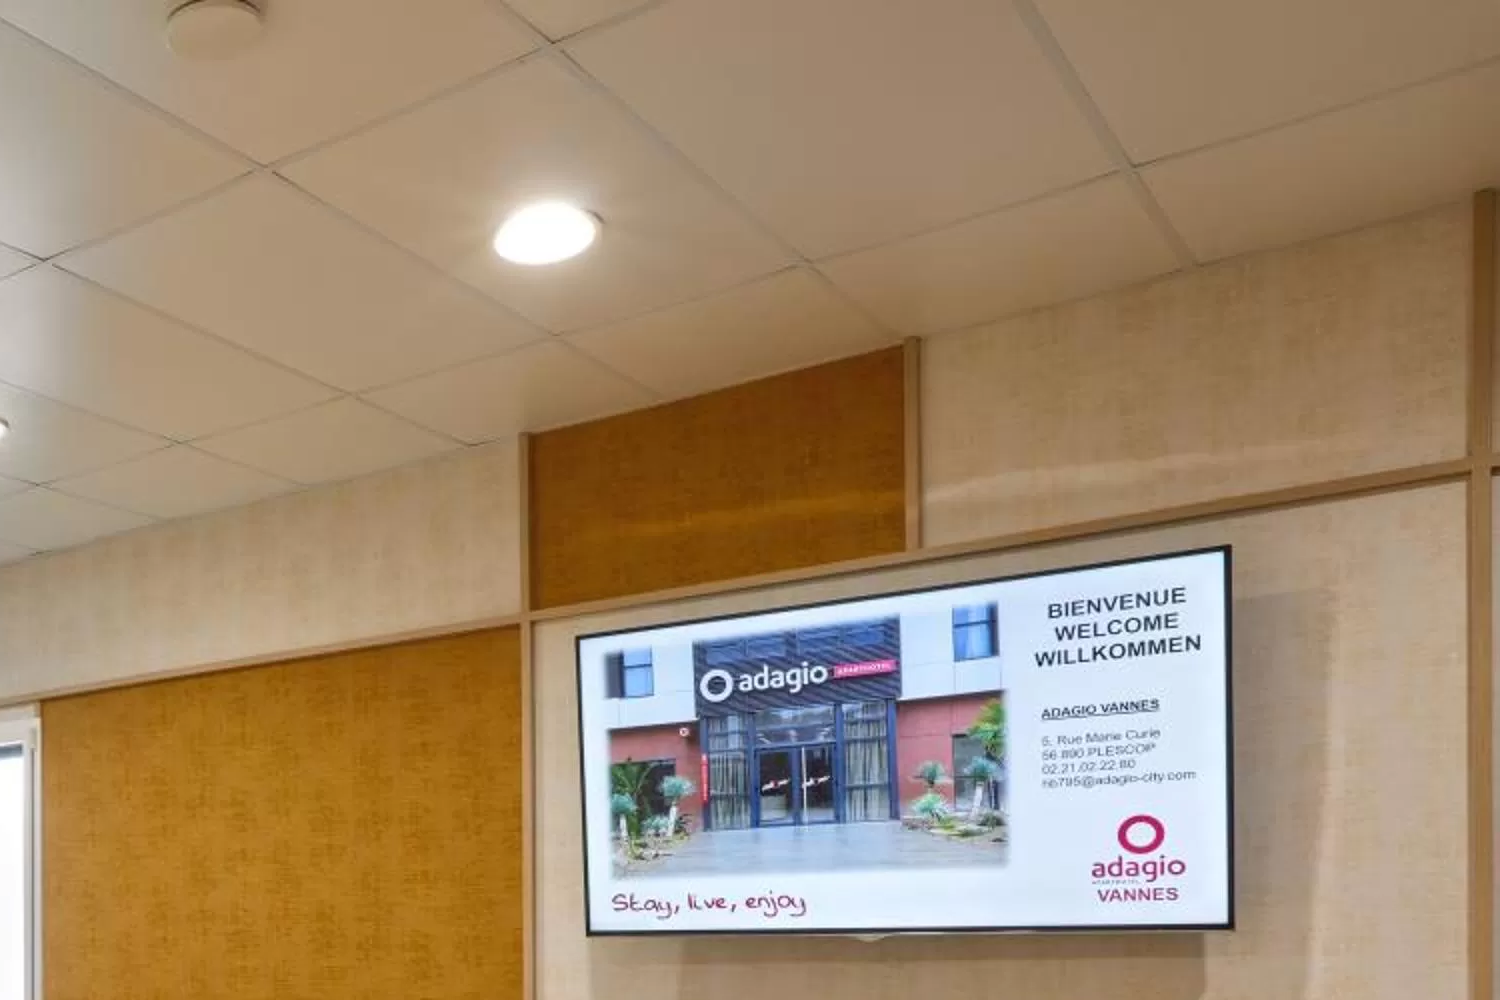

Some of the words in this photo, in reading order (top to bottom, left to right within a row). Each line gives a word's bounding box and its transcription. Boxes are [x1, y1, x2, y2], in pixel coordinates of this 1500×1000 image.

[1048, 586, 1187, 619] BIENVENUE
[1055, 612, 1179, 641] WELCOME
[1034, 634, 1202, 667] WILLKOMMEN
[738, 661, 829, 693] adagio
[1041, 703, 1097, 720] ADAGIO
[1099, 697, 1161, 714] VANNES
[1057, 734, 1084, 746] Rue
[1125, 727, 1162, 741] Curie
[1091, 854, 1187, 883] adagio
[611, 892, 681, 921] Stay,
[687, 892, 737, 913] live,
[745, 889, 808, 918] enjoy
[1097, 886, 1180, 903] VANNES
